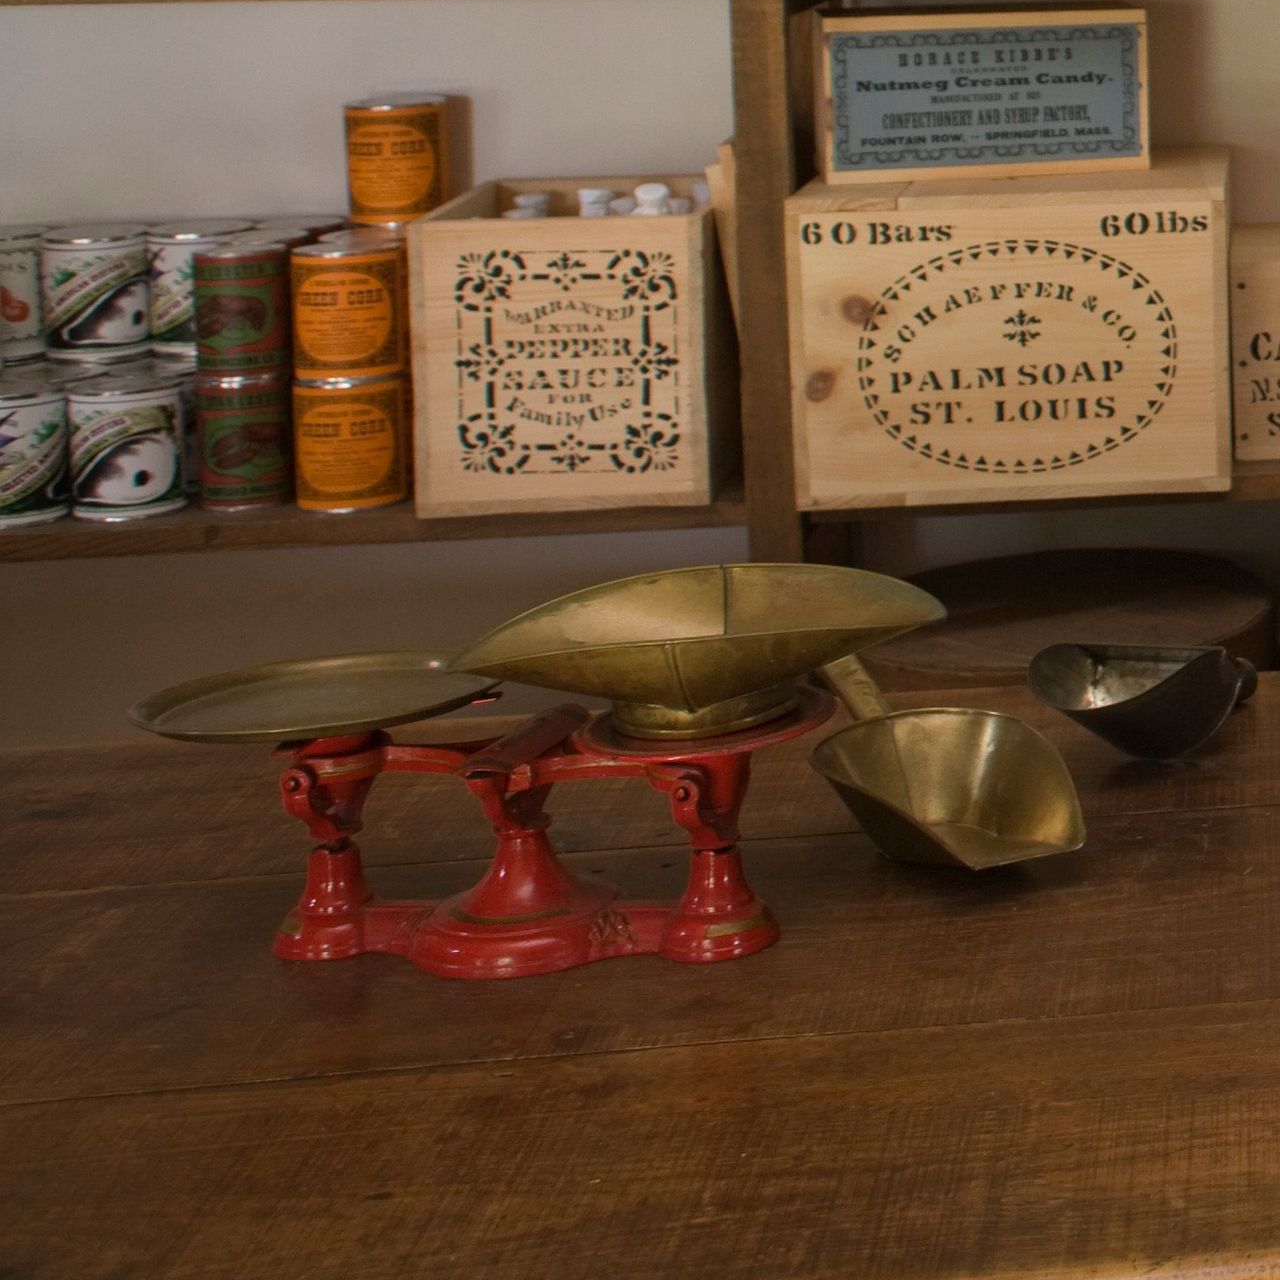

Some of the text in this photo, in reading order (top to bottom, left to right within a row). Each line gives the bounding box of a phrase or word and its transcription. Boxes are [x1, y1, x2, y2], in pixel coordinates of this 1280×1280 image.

[898, 47, 1073, 67] HORACE KIBBE'S
[856, 71, 1114, 93] Nutmeg Cream Candy.
[882, 110, 974, 129] CONFECTIONERY
[977, 108, 1000, 125] AND
[1004, 106, 1040, 124] SYRUP
[391, 140, 424, 155] CORN
[861, 135, 927, 147] FOUNTAIN
[869, 222, 954, 245] Bars
[347, 288, 383, 305] CORN
[534, 324, 604, 334] EXTRA
[883, 281, 1138, 363] SCHAEFFER & CO.
[505, 338, 631, 359] PEPPER
[503, 368, 634, 389] SAUCE
[889, 359, 1124, 394] PALM SOAP
[548, 393, 592, 404] FOR
[506, 397, 632, 429] Family Use
[910, 396, 1117, 426] ST. LOUIS
[350, 419, 386, 436] CORN
